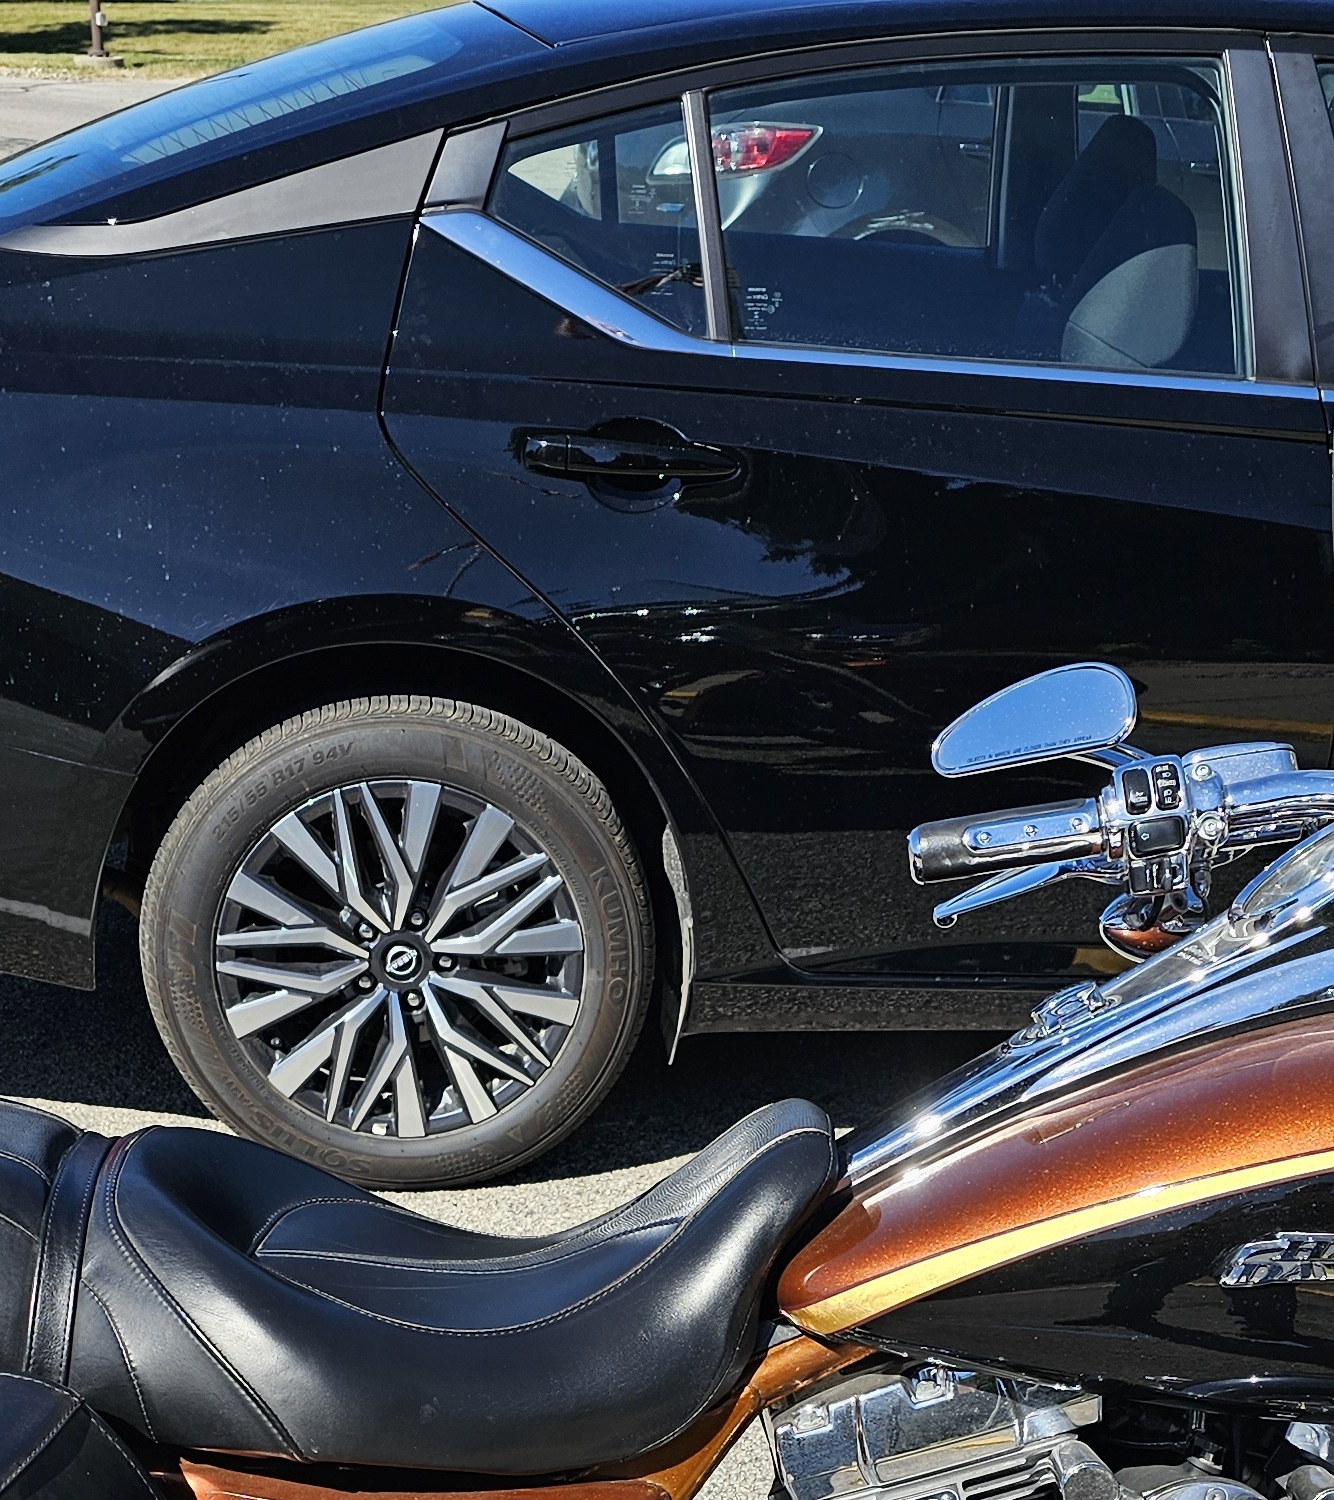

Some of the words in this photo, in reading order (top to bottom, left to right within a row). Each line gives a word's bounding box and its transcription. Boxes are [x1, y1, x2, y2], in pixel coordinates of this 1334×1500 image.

[212, 780, 268, 843] 215/55
[272, 757, 305, 787] R17
[312, 741, 354, 766] 94V
[590, 865, 628, 1006] KUMHO
[251, 1109, 372, 1174] SOLUS
